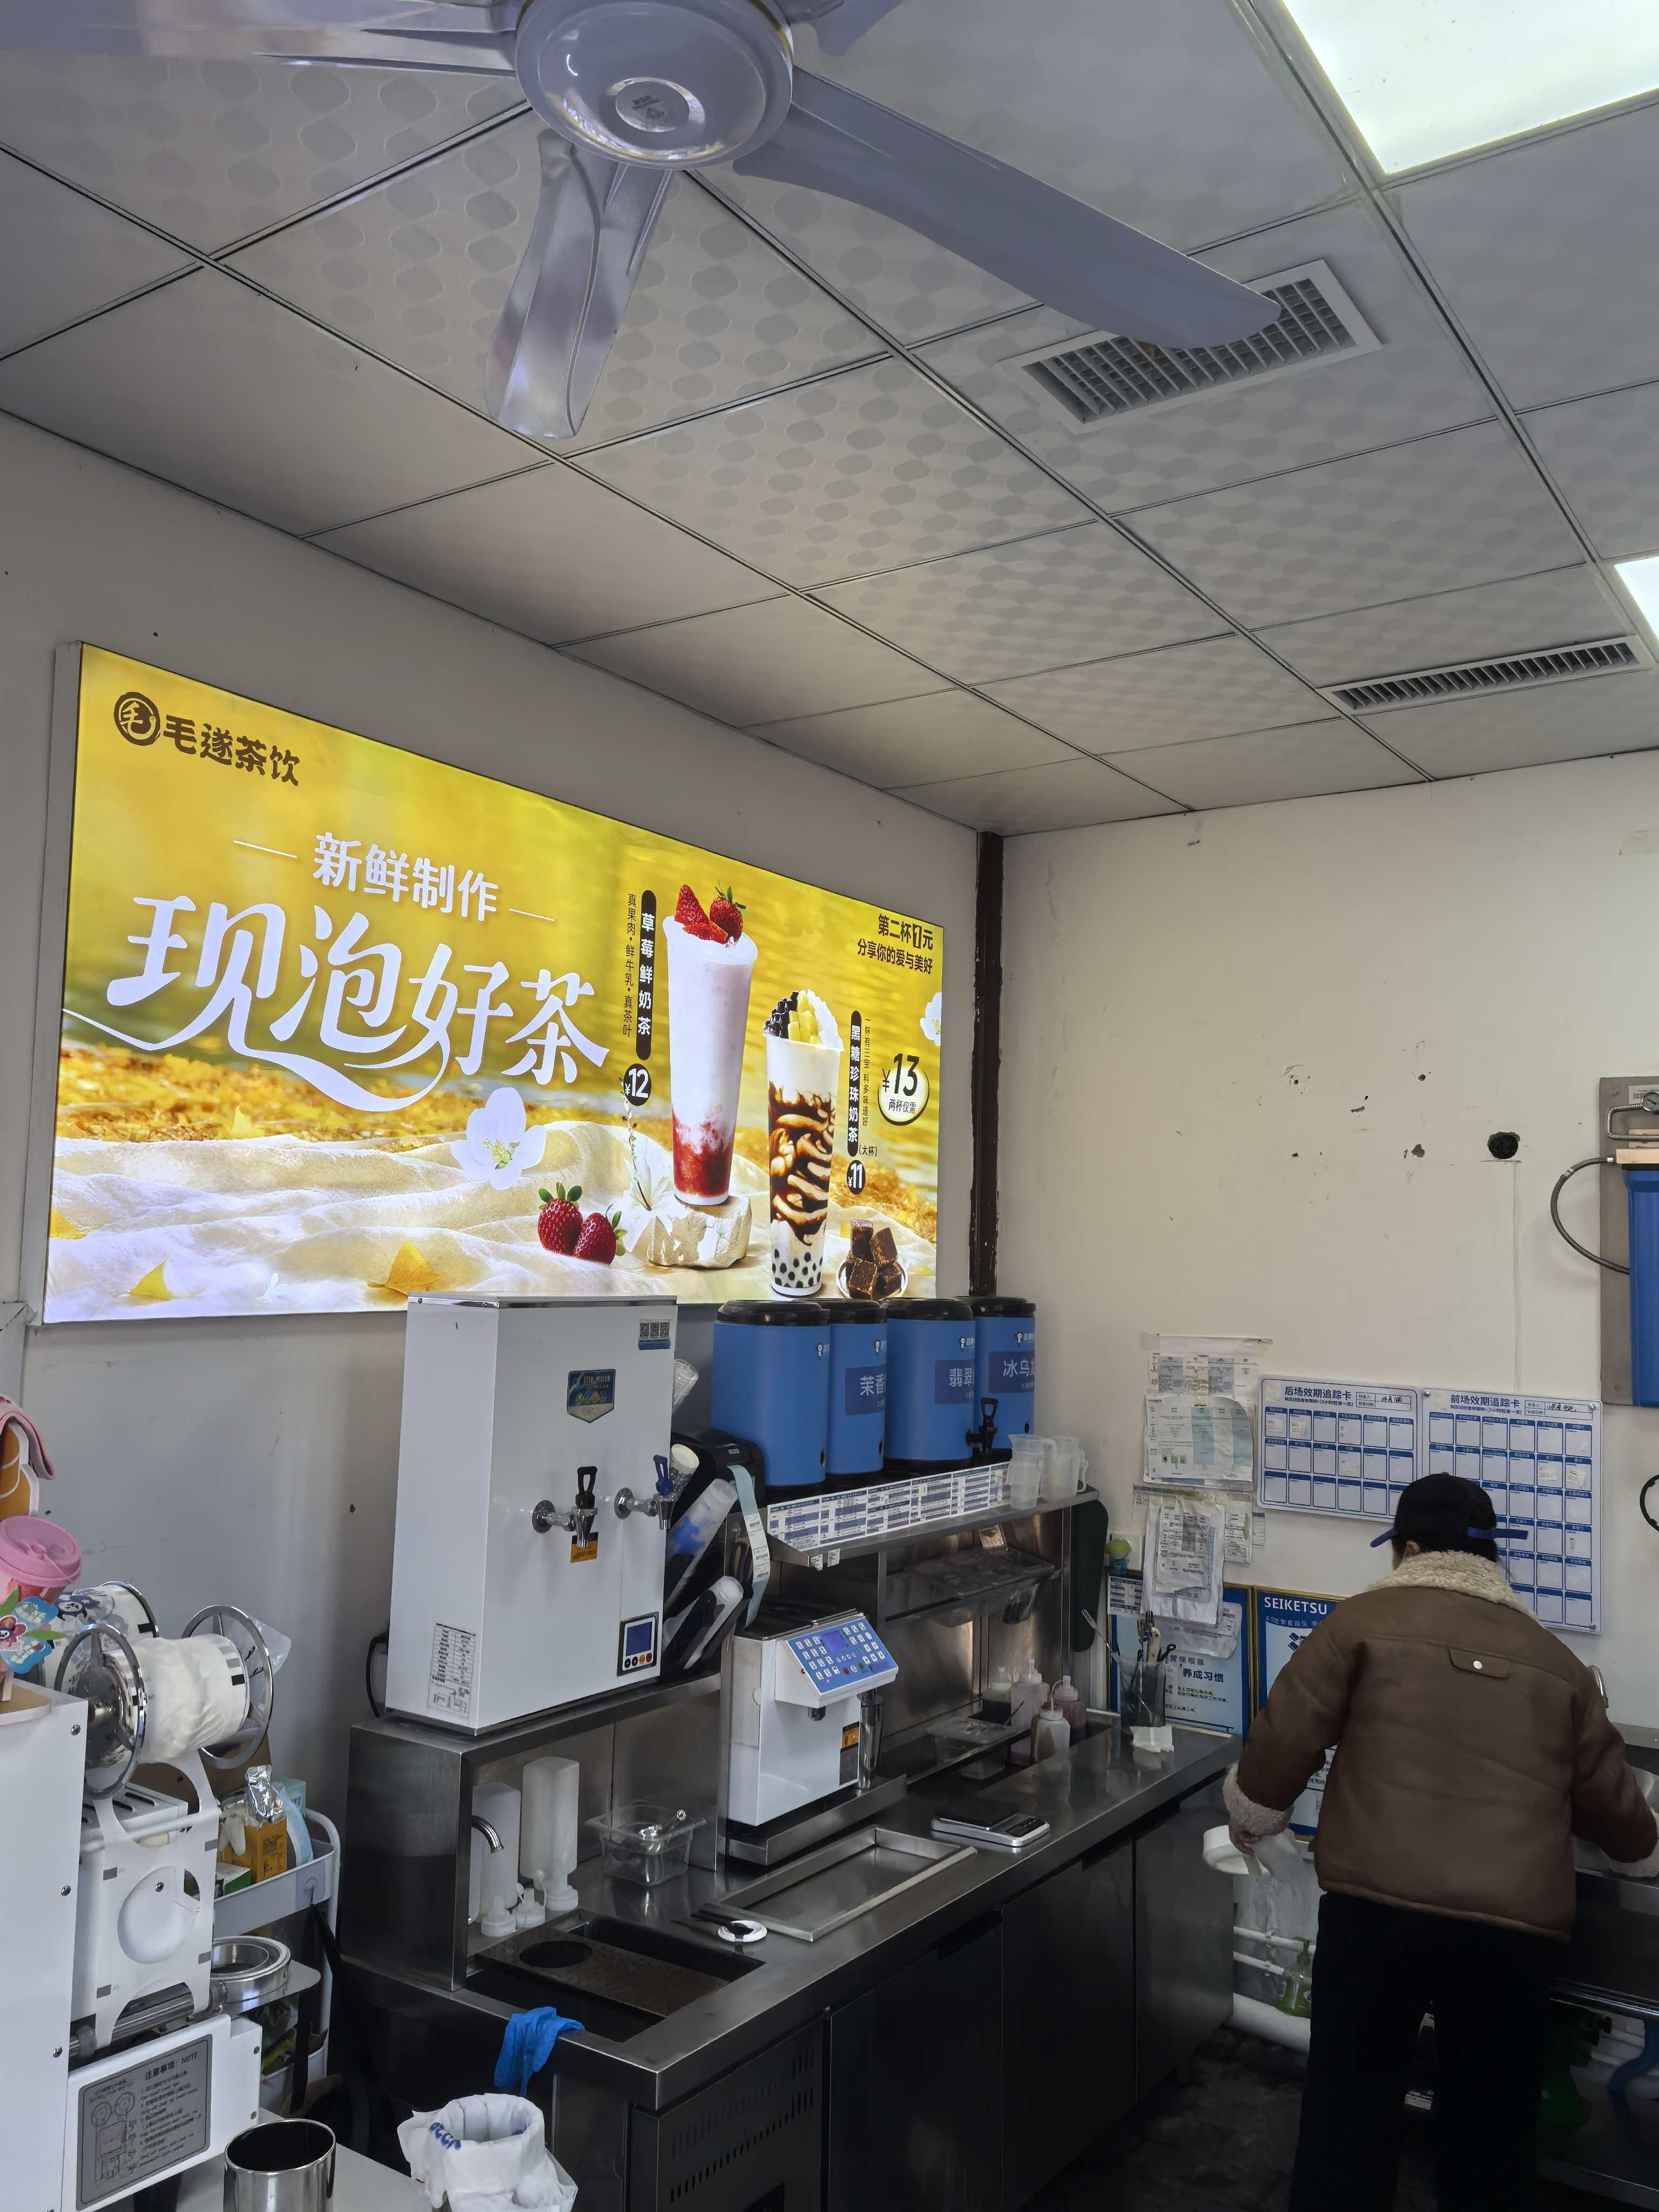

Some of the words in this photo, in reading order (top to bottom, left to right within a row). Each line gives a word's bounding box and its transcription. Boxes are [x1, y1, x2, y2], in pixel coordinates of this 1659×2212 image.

[313, 832, 499, 921] 新鲜制作
[637, 912, 655, 1036] 草莓鲜奶茶
[857, 938, 933, 974] 分享你的爱与美好
[63, 895, 609, 1112] 现泡好茶
[848, 1025, 861, 1143] 黑糖珍珠奶茶
[888, 1098, 917, 1115] 两杯仅需
[1284, 1386, 1352, 1400] 后场效期追踪卡
[1451, 1393, 1520, 1408] 前场效期追踪卡
[1264, 1596, 1327, 1615] SEIKETSU
